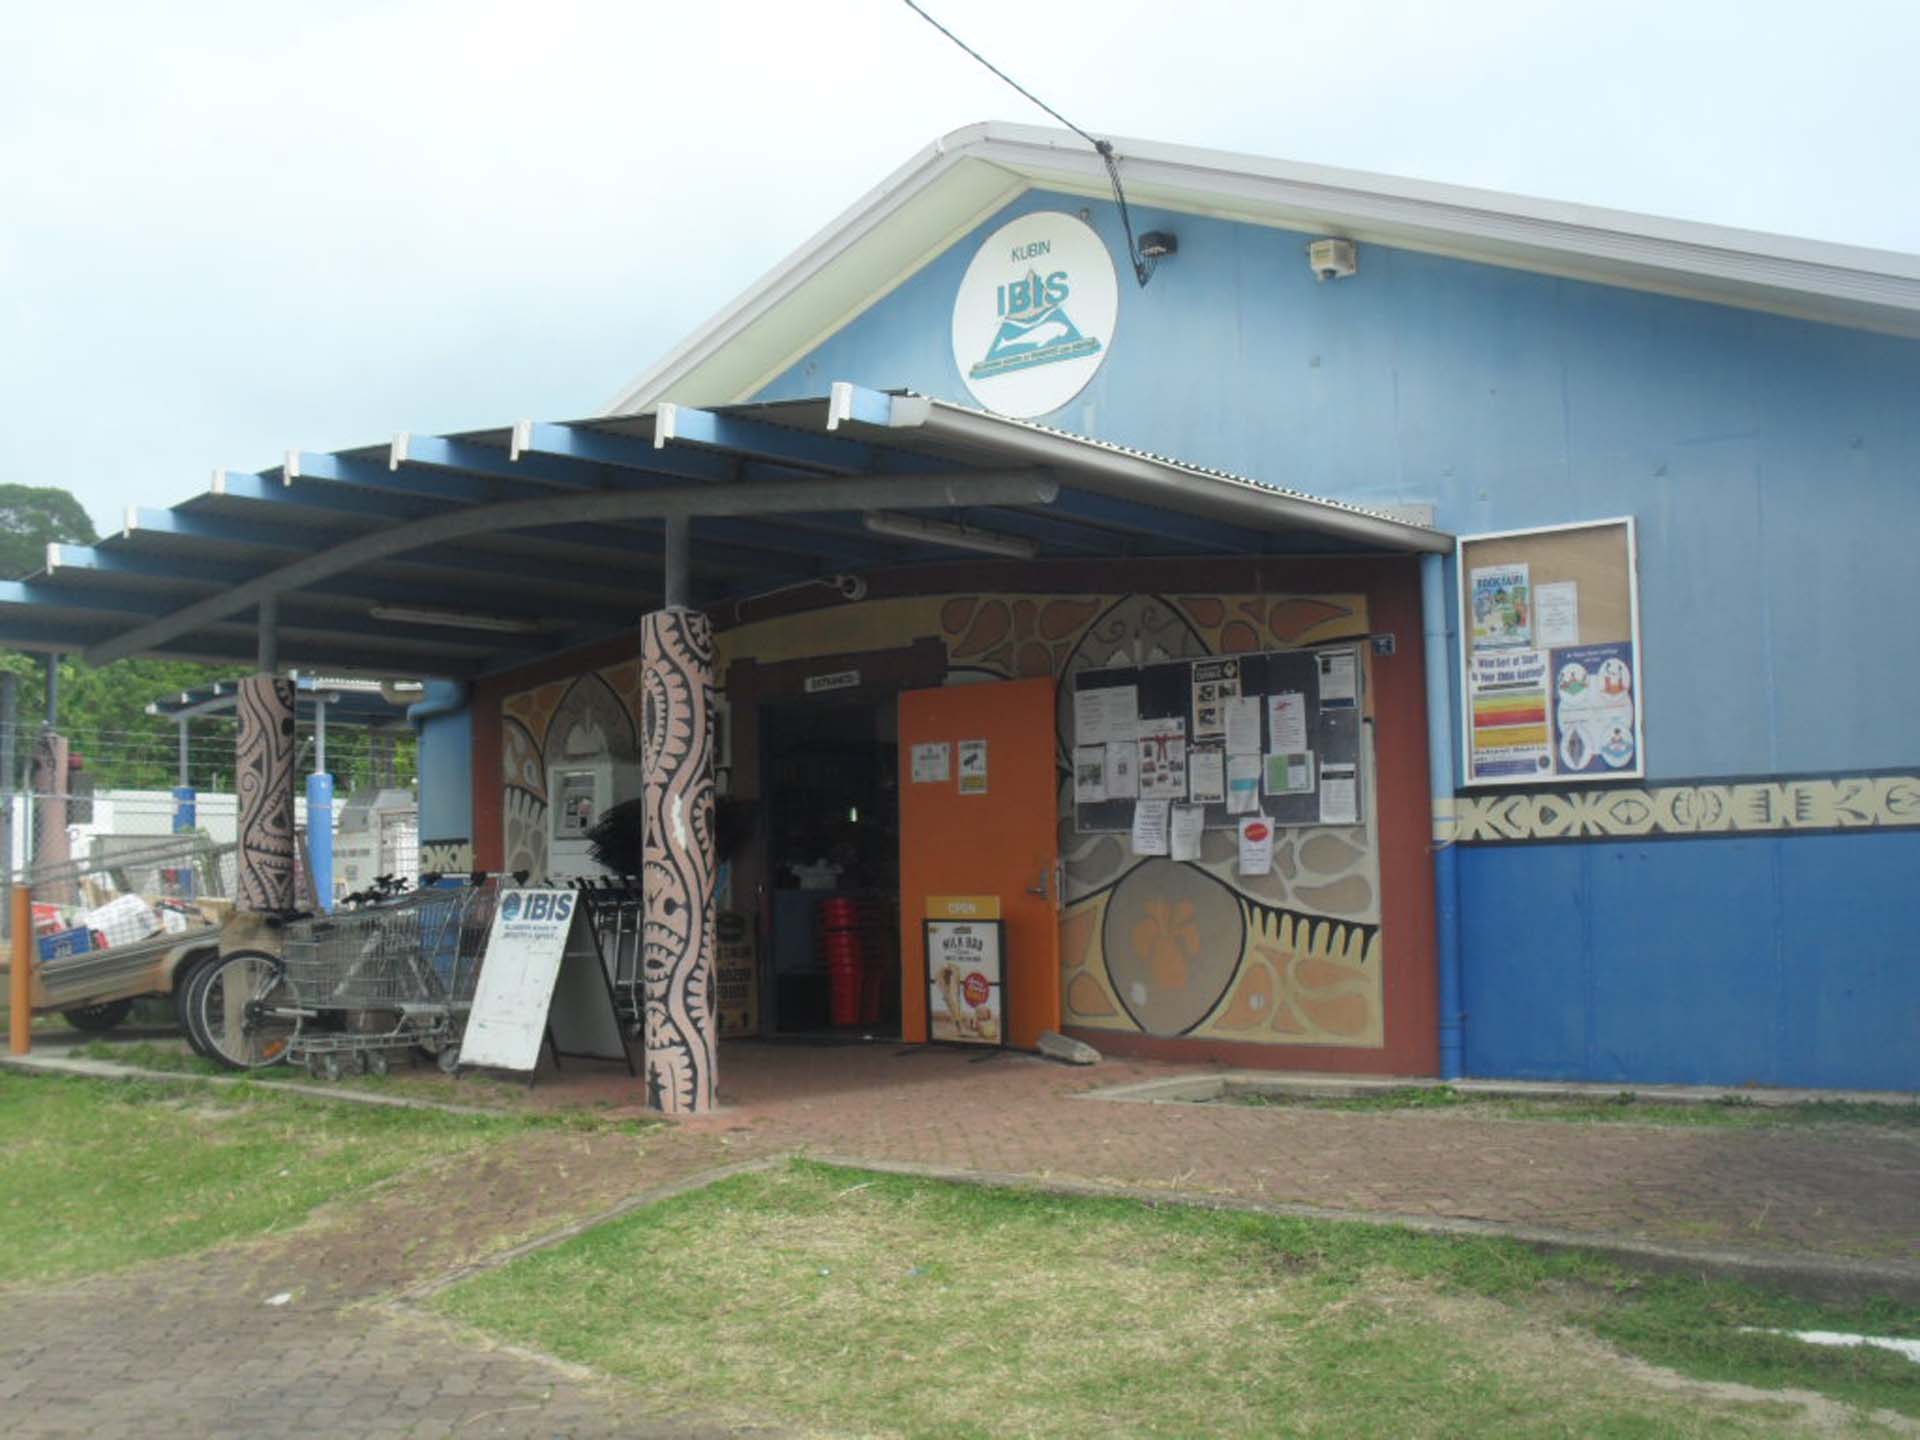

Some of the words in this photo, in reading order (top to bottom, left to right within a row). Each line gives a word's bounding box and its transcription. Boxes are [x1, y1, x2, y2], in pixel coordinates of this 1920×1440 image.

[1012, 240, 1051, 263] KUBIN
[997, 271, 1070, 317] IBIS
[523, 893, 573, 921] IBIS
